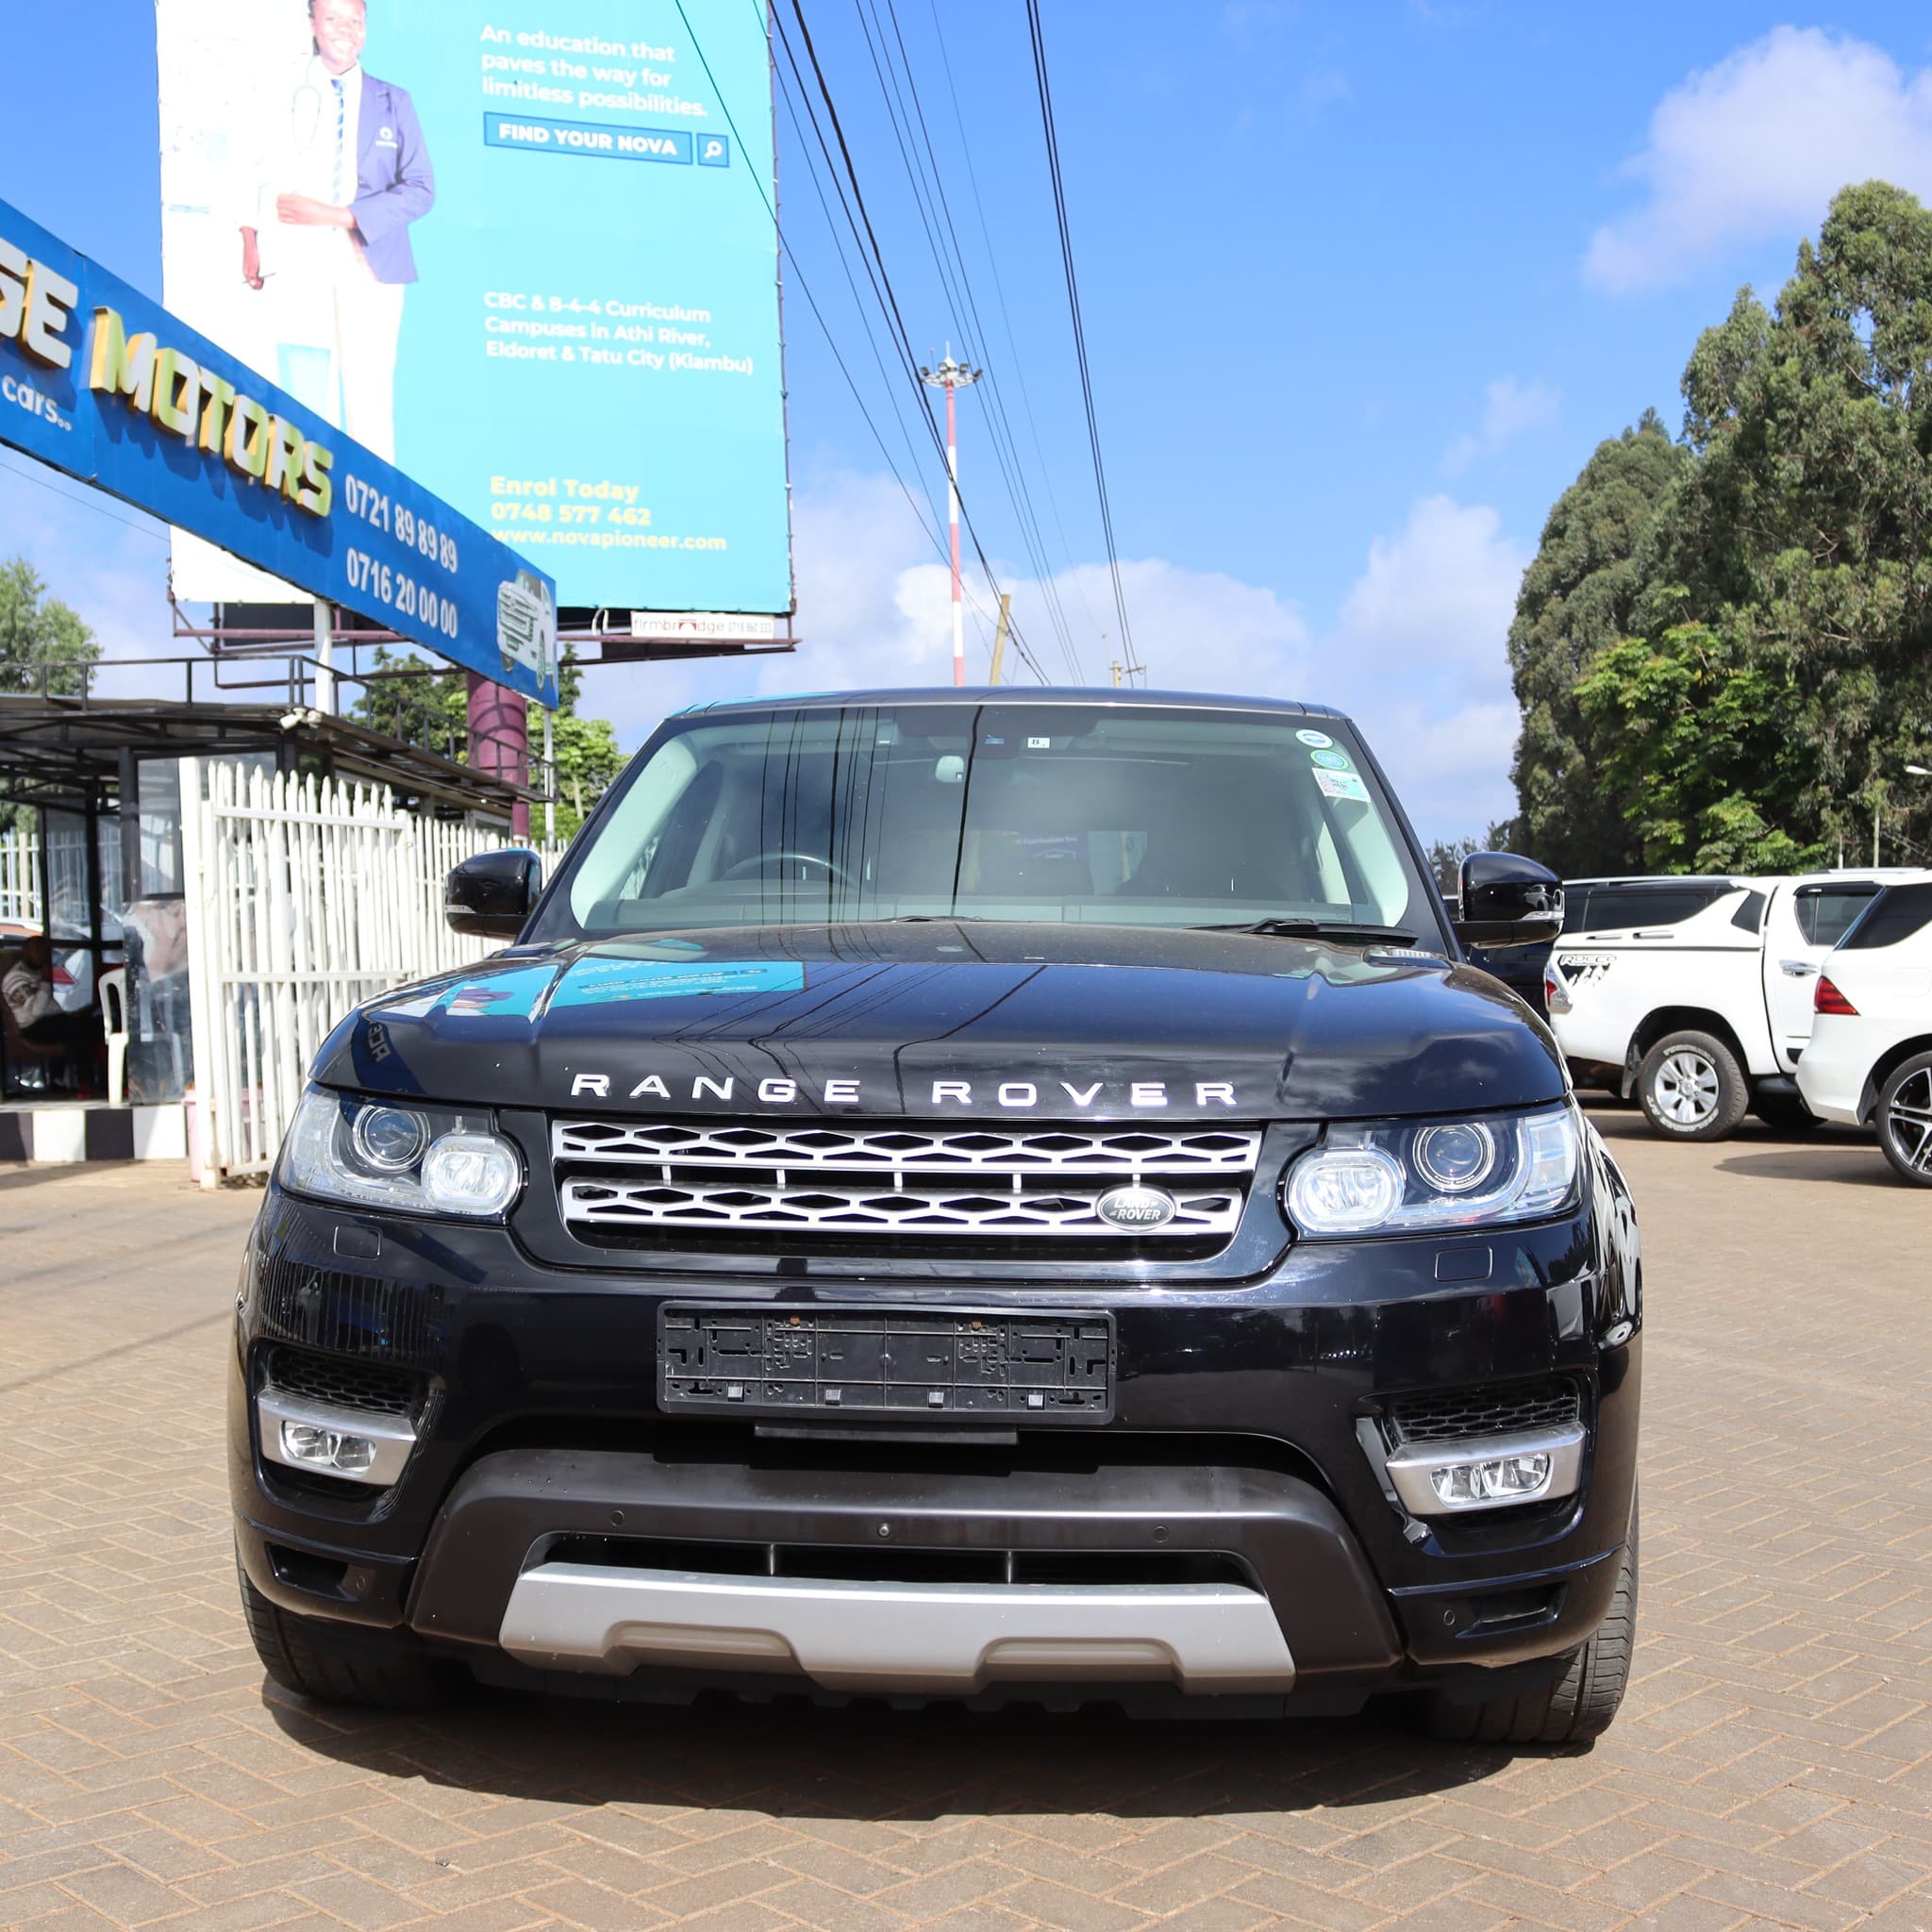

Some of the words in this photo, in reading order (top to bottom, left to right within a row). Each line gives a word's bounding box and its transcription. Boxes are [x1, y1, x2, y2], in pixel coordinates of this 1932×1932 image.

[480, 25, 511, 43] An
[517, 30, 625, 57] education
[631, 42, 675, 62] that
[481, 53, 545, 75] paves
[551, 59, 588, 79] the
[592, 66, 638, 88] way
[641, 68, 671, 87] for
[482, 76, 574, 104] limitless
[578, 92, 708, 117] possibilities.
[499, 123, 549, 142] FIND
[554, 129, 612, 149] YOUR
[618, 135, 677, 155] NOVA
[484, 291, 526, 309] CBC
[530, 295, 544, 311] &
[549, 296, 601, 315] 8-4-4
[605, 300, 710, 323] Curriculum
[485, 316, 587, 339] Campuses
[591, 323, 609, 339] in
[613, 325, 654, 342] Athi
[658, 327, 710, 348] River,
[486, 341, 557, 360] Eldoret
[561, 344, 575, 361] &
[579, 346, 623, 365] Tatu
[626, 349, 664, 370] City
[669, 352, 754, 375] (Kiambu)
[90, 306, 334, 517] MOTORS
[491, 476, 557, 497] Enrol
[562, 479, 640, 504] Today
[345, 474, 389, 532] 0721
[394, 504, 415, 547] 89
[418, 519, 438, 561] 89
[440, 533, 458, 574] 89
[491, 503, 552, 522] 0748
[558, 505, 601, 524] 577
[607, 507, 652, 526] 462
[491, 527, 727, 551] www.novapioneer.com
[346, 547, 391, 604] 0716
[395, 573, 415, 617] 20
[419, 586, 438, 628] 00
[441, 598, 458, 639] 00
[570, 1073, 860, 1104] RANGE
[931, 1080, 1239, 1108] ROVER
[1117, 1208, 1161, 1220] ROVER
